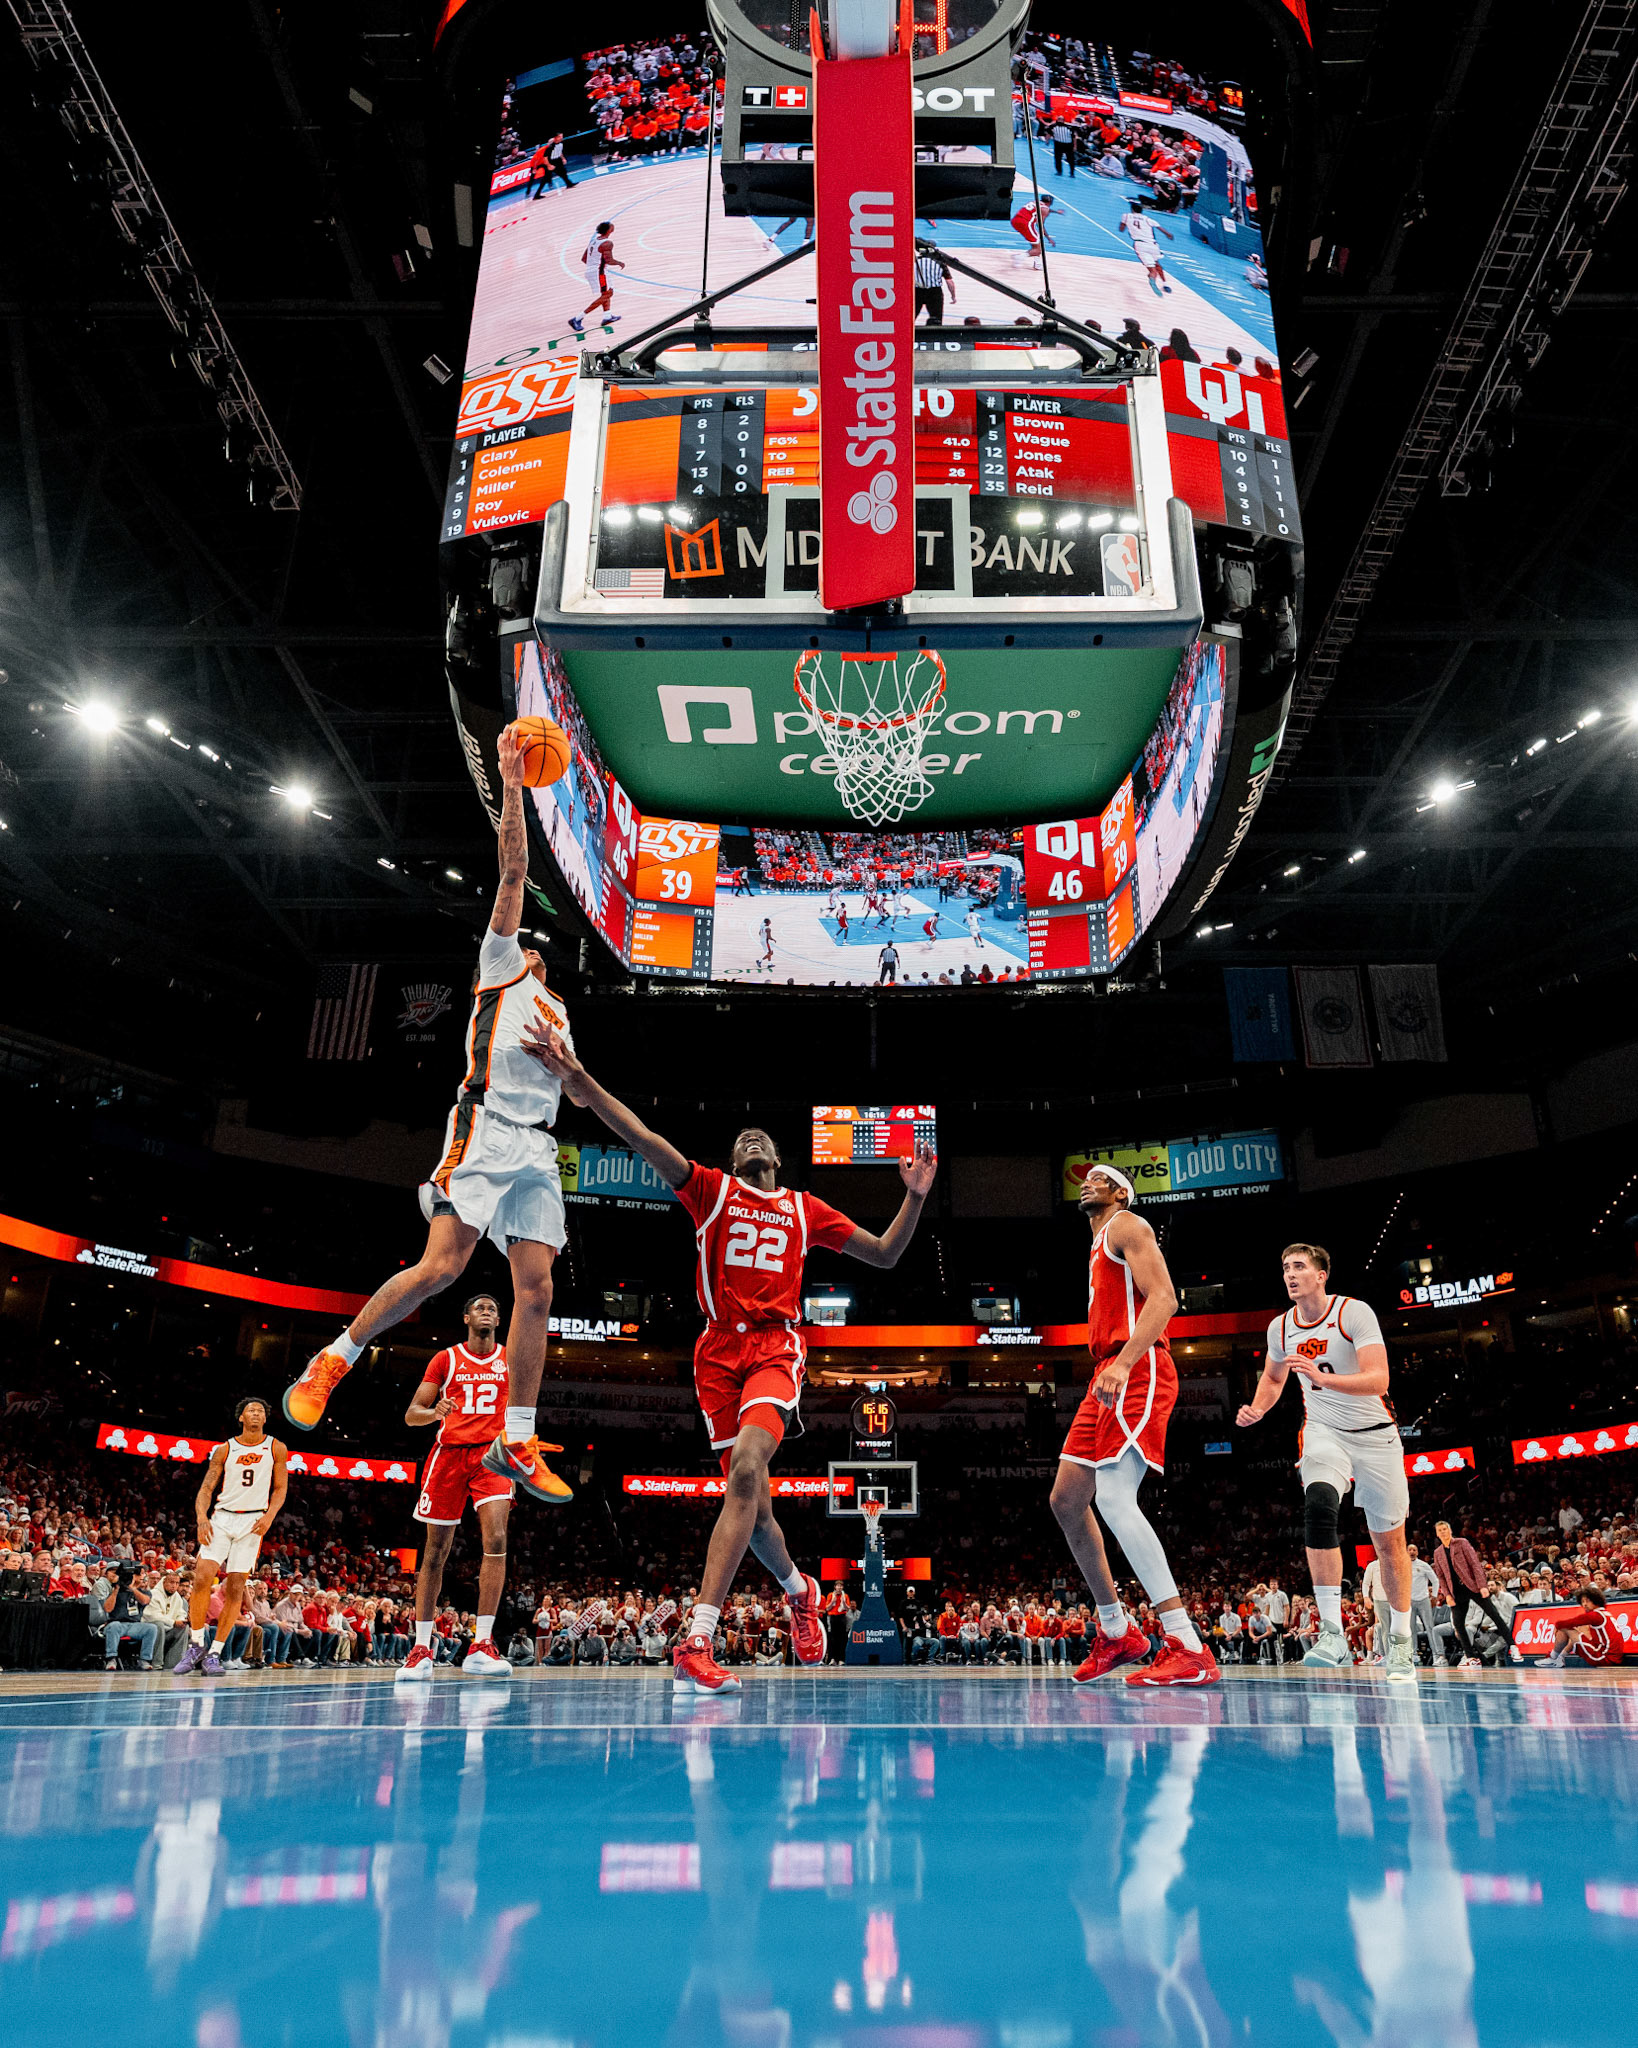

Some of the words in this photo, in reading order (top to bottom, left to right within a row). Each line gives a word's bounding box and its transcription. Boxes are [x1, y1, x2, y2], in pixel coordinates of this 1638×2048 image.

[694, 398, 713, 409] PTS
[736, 396, 754, 406] FLS
[986, 396, 996, 408] #
[1013, 398, 1061, 414] PLAYER
[697, 418, 708, 429] 8
[738, 414, 749, 425] 2
[989, 414, 996, 425] 1
[1013, 416, 1065, 431] Brown
[460, 441, 469, 453] #
[483, 425, 526, 447] PLAYER
[698, 433, 705, 444] 1
[737, 431, 749, 441] 0
[768, 436, 798, 446] FG%
[943, 437, 971, 447] 41.0
[988, 430, 998, 441] 5
[1013, 432, 1070, 448] Wague
[1228, 432, 1246, 445] PTS
[1265, 441, 1282, 454] FLS
[461, 459, 467, 470] 1
[481, 448, 518, 464] Clary
[695, 450, 706, 461] 7
[739, 447, 746, 458] 1
[768, 452, 787, 461] TO
[952, 451, 962, 461] 5
[984, 446, 1003, 458] 12
[1014, 449, 1062, 463] Jones
[1230, 450, 1248, 462] 10
[1271, 459, 1278, 470] 1
[456, 475, 466, 486] 4
[478, 459, 542, 480] Coleman
[691, 467, 709, 479] 13
[735, 464, 748, 475] 0
[767, 467, 795, 476] REB
[948, 468, 966, 477] 26
[984, 463, 1005, 475] 22
[1015, 465, 1055, 480] Atak
[1235, 466, 1246, 477] 4
[1273, 475, 1280, 486] 1
[455, 491, 463, 502] 5
[476, 480, 516, 497] Miller
[692, 484, 704, 495] 4
[734, 481, 747, 492] 0
[984, 480, 1005, 492] 35
[1015, 482, 1054, 496] Reid
[1237, 482, 1248, 493] 9
[1275, 491, 1282, 502] 1
[452, 508, 461, 519] 9
[475, 499, 503, 514] Roy
[1239, 498, 1249, 509] 3
[1278, 507, 1285, 518] 1
[447, 524, 462, 536] 19
[472, 510, 530, 530] Vukovic
[1241, 515, 1251, 526] 5
[1278, 524, 1288, 535] 0
[1109, 584, 1129, 596] NBA
[612, 840, 629, 880] 46
[1112, 839, 1128, 882] 39
[659, 868, 692, 900] 39
[1048, 869, 1083, 901] 46
[636, 902, 658, 911] PLAYER
[694, 908, 705, 916] PTS
[1029, 909, 1049, 917] PLAYER
[1085, 903, 1097, 911] PTS
[400, 983, 453, 1003] THUNDER
[1267, 992, 1279, 1033] OKLAHOMA
[834, 1109, 852, 1119] 39
[896, 1108, 915, 1119] 46
[583, 1157, 634, 1187] LOUD
[1174, 1146, 1226, 1184] LOUD
[1232, 1144, 1277, 1174] CITY
[562, 1194, 600, 1205] UNDER
[616, 1200, 642, 1209] EXIT
[645, 1202, 671, 1212] NOW
[1140, 1191, 1196, 1204] THUNDER
[1213, 1187, 1239, 1198] EXIT
[1242, 1184, 1270, 1195] NOW
[728, 1206, 794, 1228] OKLAHOMA
[95, 1244, 136, 1260] PRESENTED
[136, 1252, 148, 1262] BY
[724, 1221, 789, 1273] 22
[1415, 1274, 1495, 1303] BEDLAM
[1433, 1294, 1482, 1308] BASKETBALL
[548, 1317, 620, 1336] BEDLAM
[988, 1326, 1022, 1334] PRESENTED
[1022, 1326, 1031, 1334] BY
[562, 1332, 606, 1342] BASKETBALL
[455, 1373, 505, 1382] OKLAHOMA
[461, 1383, 498, 1415] 12
[863, 1402, 889, 1414] 16:16
[869, 1414, 887, 1434] 14
[241, 1468, 255, 1487] 9
[643, 1479, 696, 1492] StateFarm
[571, 1602, 603, 1636] DEFENSE
